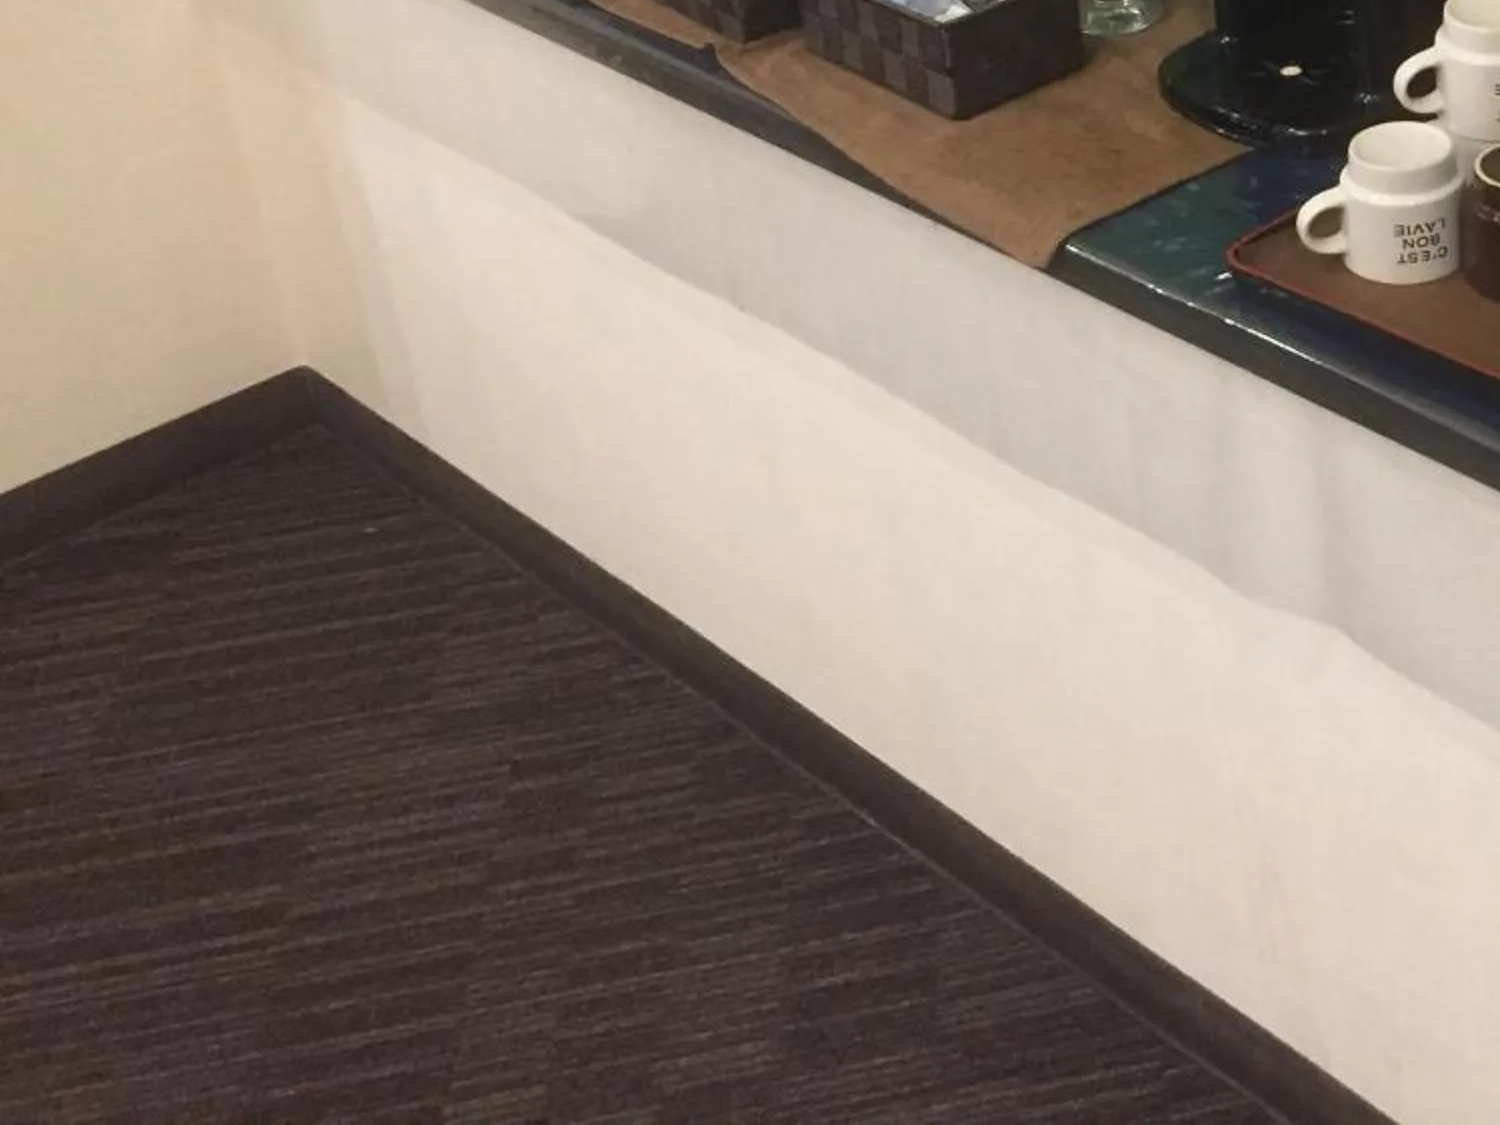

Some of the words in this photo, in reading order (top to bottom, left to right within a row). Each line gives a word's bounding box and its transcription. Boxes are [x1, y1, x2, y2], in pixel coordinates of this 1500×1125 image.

[1394, 217, 1446, 237] LAVIE
[1402, 233, 1440, 250] BON
[1396, 245, 1448, 264] C'EST
